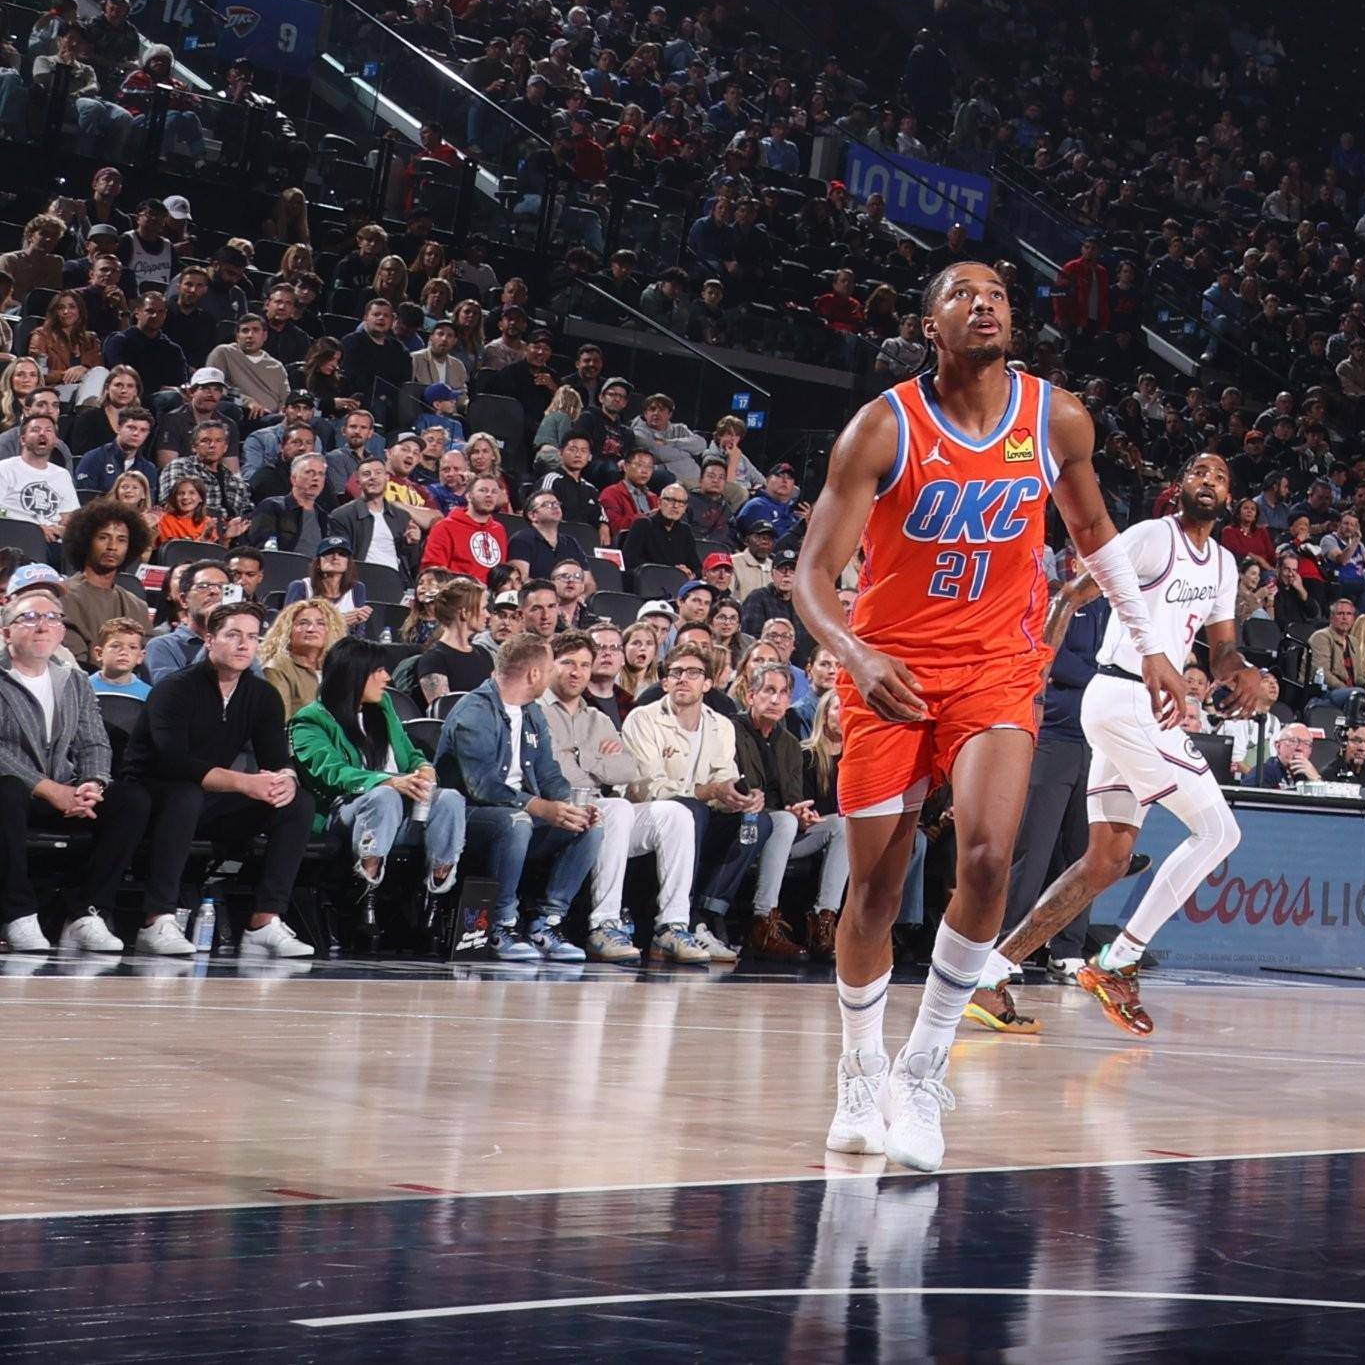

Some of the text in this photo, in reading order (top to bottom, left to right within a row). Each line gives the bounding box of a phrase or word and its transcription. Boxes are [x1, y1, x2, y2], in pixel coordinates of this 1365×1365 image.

[278, 22, 298, 54] 9
[850, 159, 984, 224] INTUIT
[902, 476, 1042, 544] OKC
[927, 548, 992, 603] 21
[1184, 613, 1203, 645] 5
[1183, 857, 1315, 927] Coors
